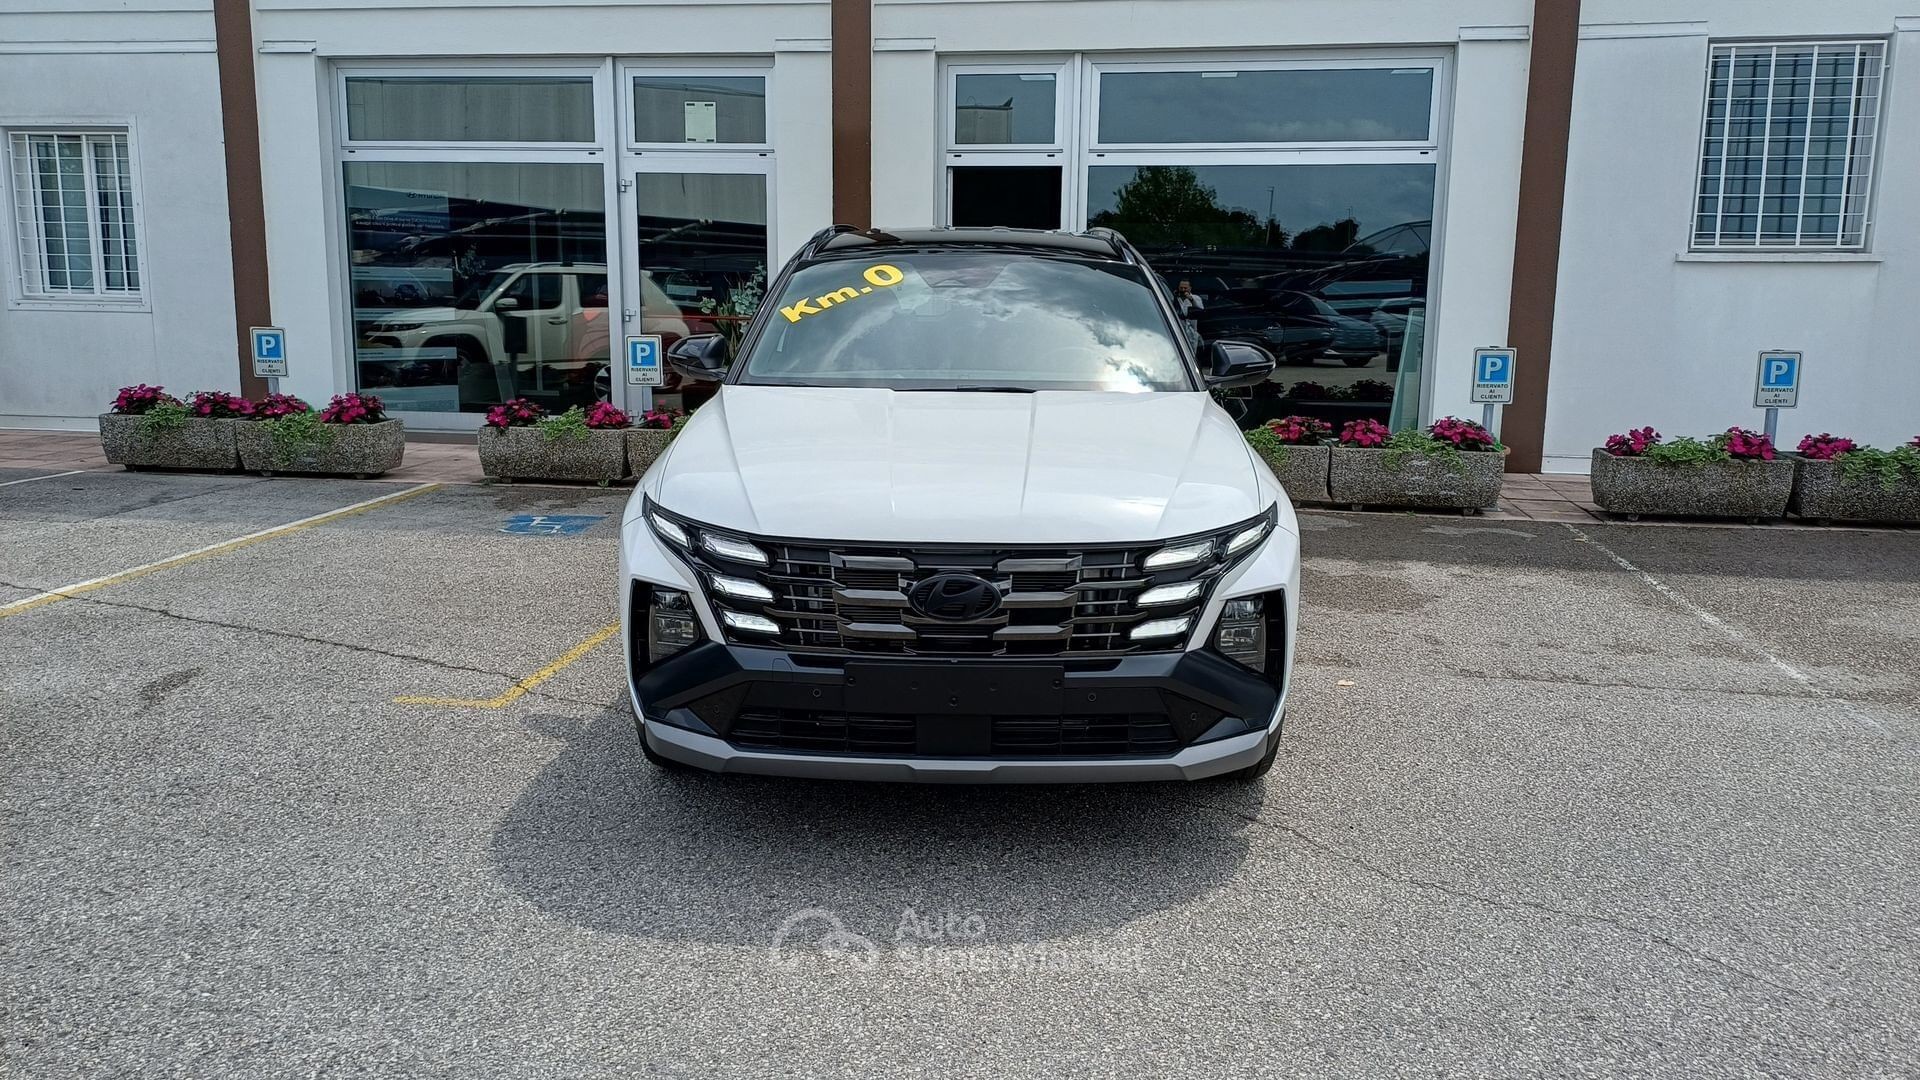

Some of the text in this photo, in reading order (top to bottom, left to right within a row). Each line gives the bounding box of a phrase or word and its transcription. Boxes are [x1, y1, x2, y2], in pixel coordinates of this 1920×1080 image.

[262, 336, 276, 355] P
[636, 344, 650, 364] P
[1484, 358, 1503, 379] P
[1769, 361, 1788, 383] P
